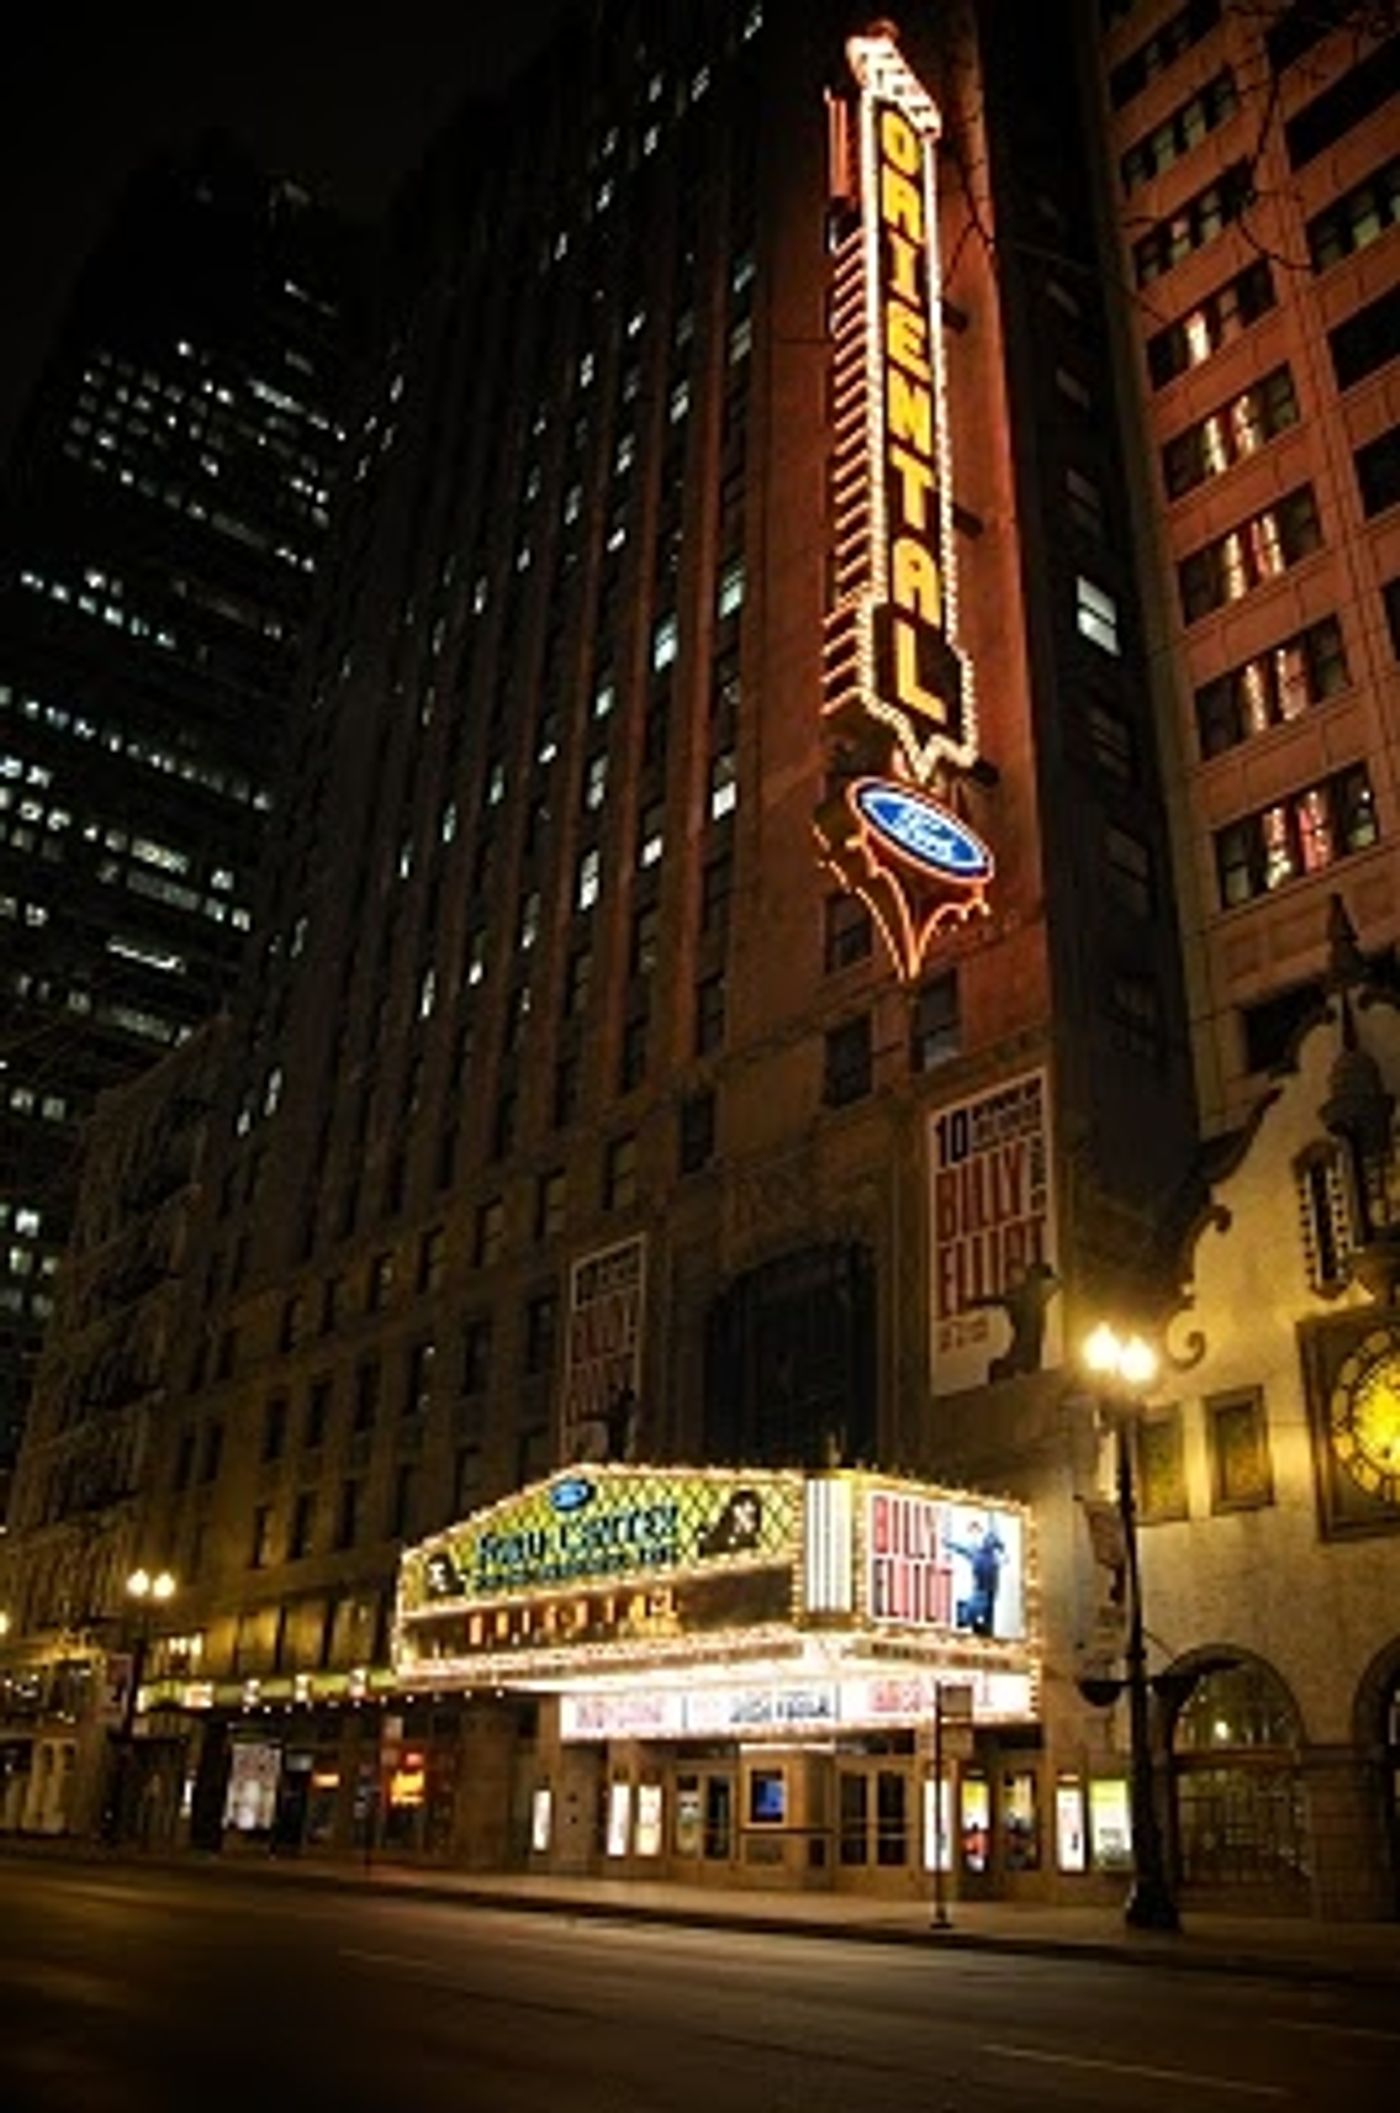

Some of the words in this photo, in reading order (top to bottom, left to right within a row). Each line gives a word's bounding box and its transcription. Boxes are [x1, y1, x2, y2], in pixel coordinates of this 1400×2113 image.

[880, 106, 947, 724] ORIENTAL
[936, 1108, 970, 1168] 10
[936, 1138, 1026, 1243] BILLY
[873, 1495, 938, 1560] BILLY
[873, 1557, 953, 1624] ELLIOT
